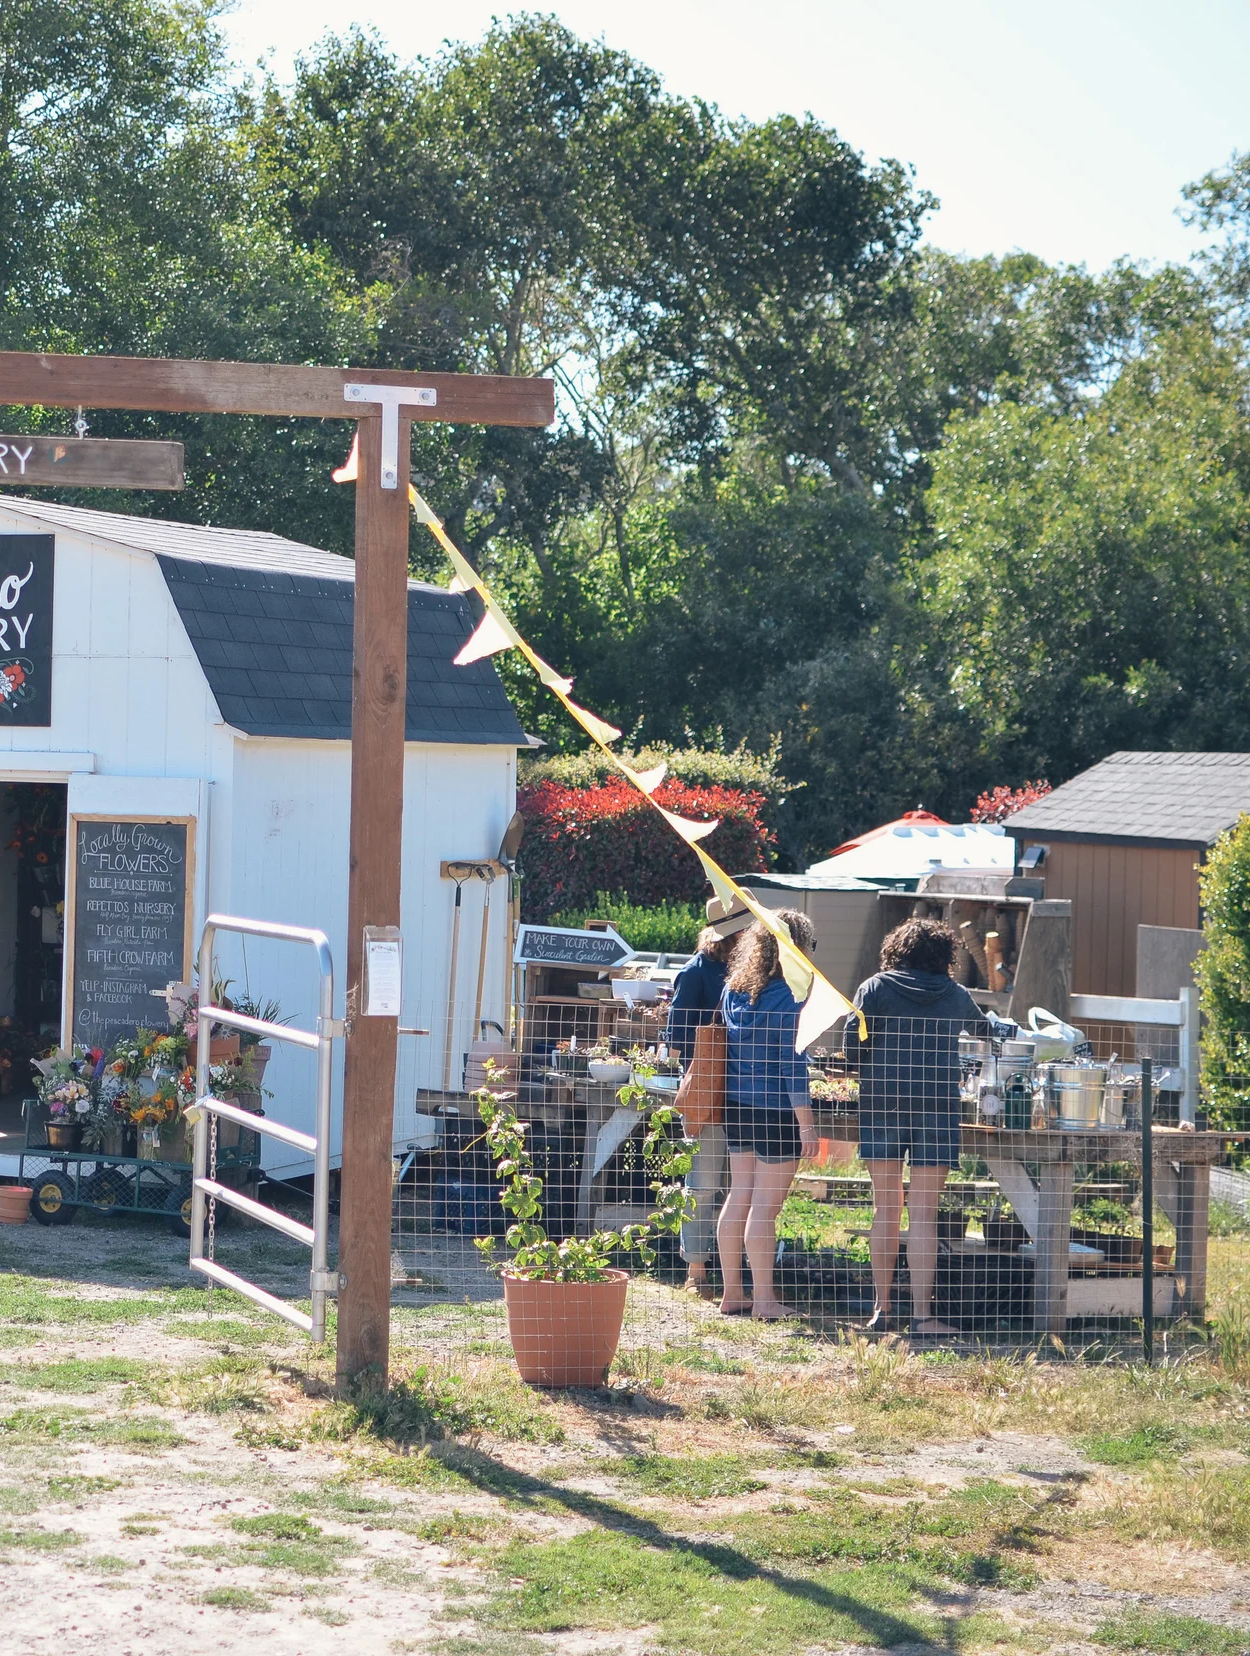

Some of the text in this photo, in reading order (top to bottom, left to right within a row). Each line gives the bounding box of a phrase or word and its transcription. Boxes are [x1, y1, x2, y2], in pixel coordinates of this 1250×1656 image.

[78, 823, 183, 865] Locally Grown
[99, 853, 169, 873] FLOWERS
[89, 876, 172, 893] BLUE HOUSE FARM
[86, 899, 177, 915] REPETTOS NURSERY
[96, 923, 168, 940] FLY GIRL FARM
[525, 932, 616, 952] MAKE YOUR OWN
[87, 948, 175, 966] FIFTH CROW FARM
[534, 944, 610, 962] Succulent Garden
[80, 979, 148, 995] YELP INSTAGRAM
[86, 992, 133, 1004] & FACEBOOK
